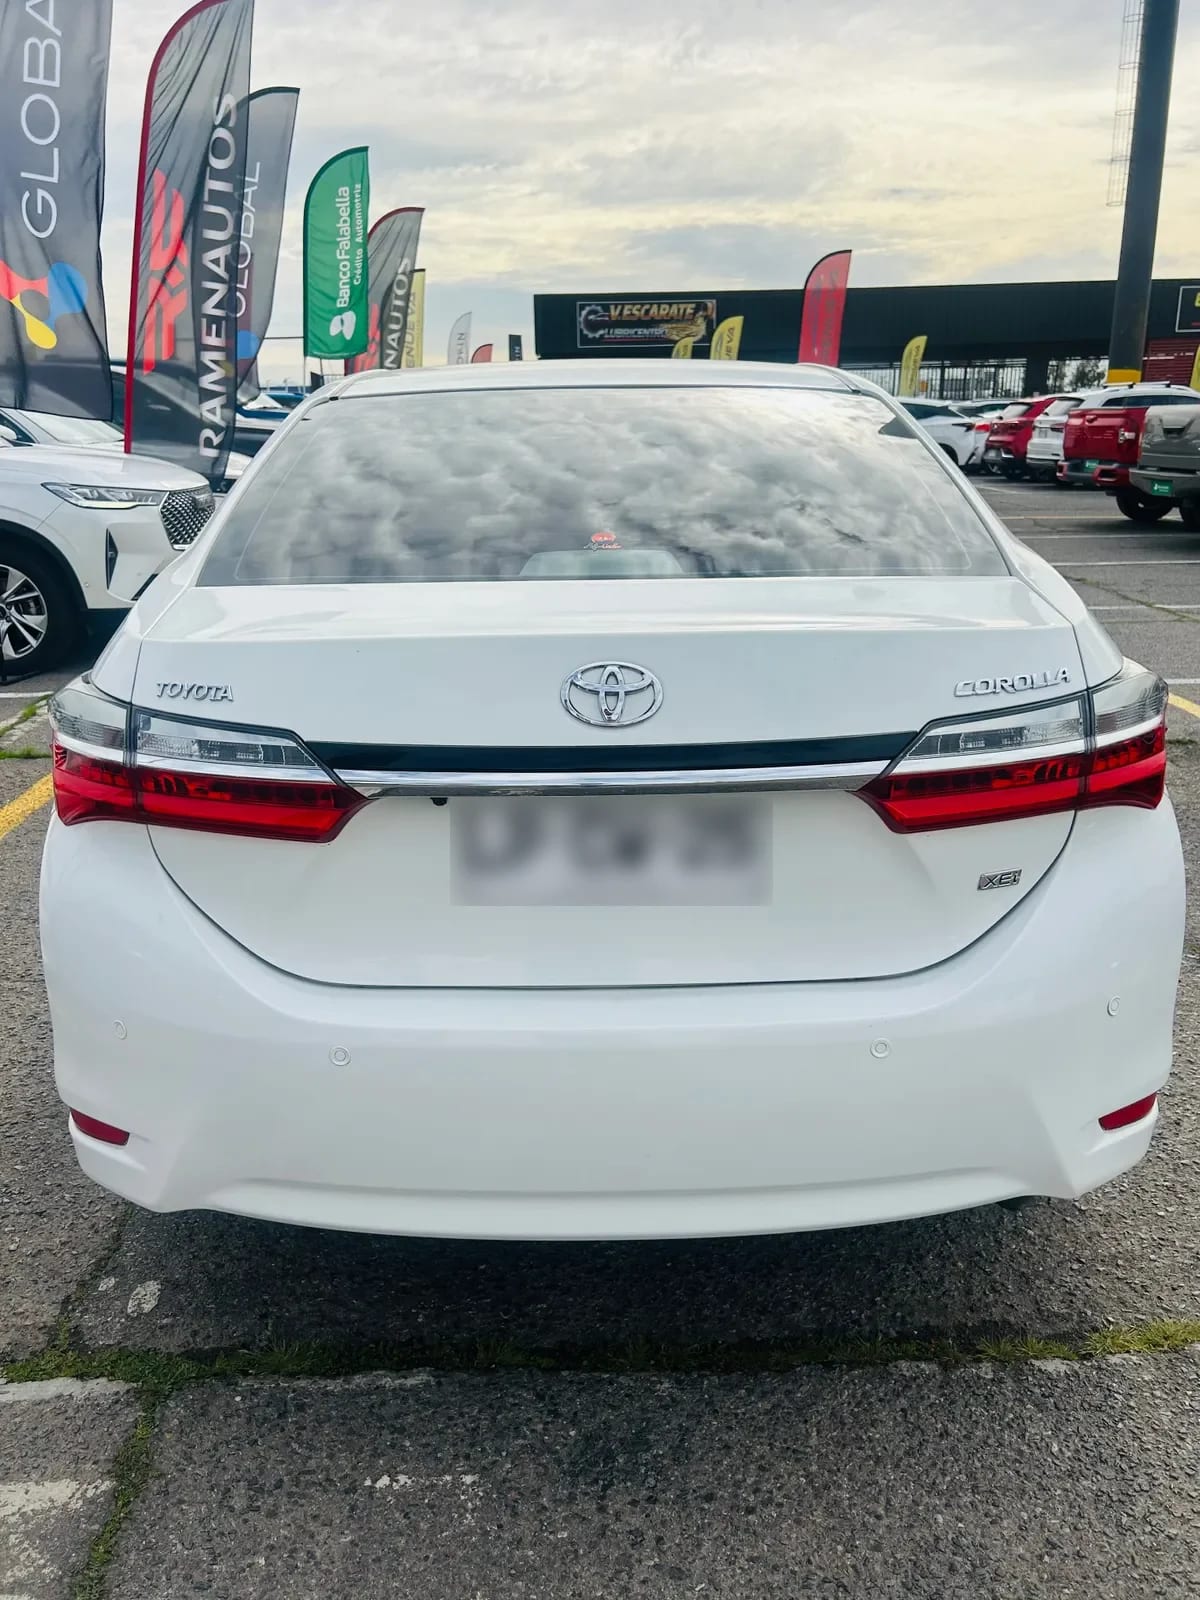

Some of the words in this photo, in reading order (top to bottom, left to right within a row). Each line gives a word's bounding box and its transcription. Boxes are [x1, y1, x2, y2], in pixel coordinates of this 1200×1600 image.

[335, 186, 350, 260] Falabella
[199, 93, 237, 459] RAMENAUTOS
[336, 261, 350, 308] Banco
[157, 682, 234, 702] TOYOTA
[954, 667, 1070, 697] COROLLA
